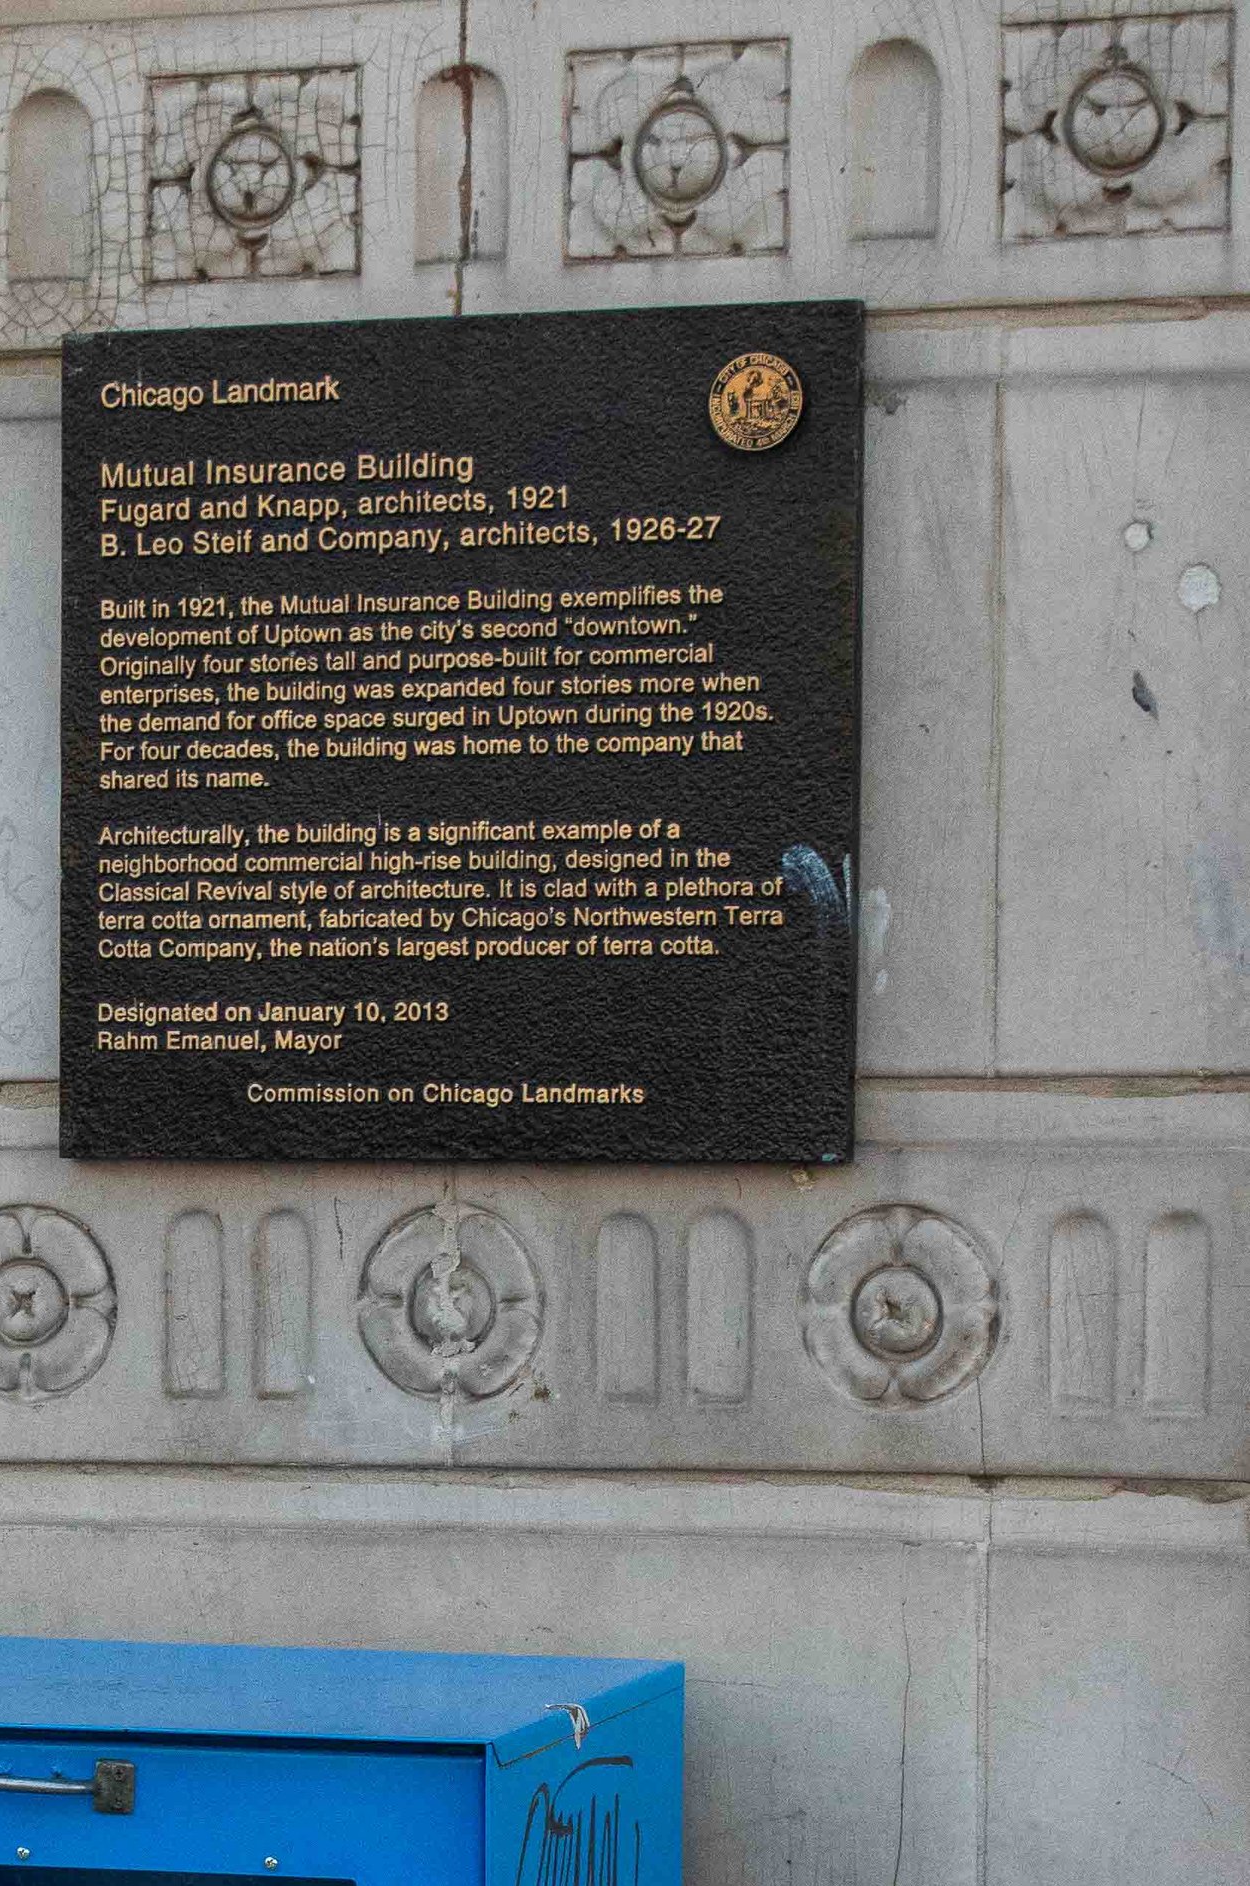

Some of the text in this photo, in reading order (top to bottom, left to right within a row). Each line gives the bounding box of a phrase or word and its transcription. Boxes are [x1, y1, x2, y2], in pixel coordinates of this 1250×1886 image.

[100, 374, 339, 410] Chicago Landmark
[101, 452, 472, 487] Mutual Insurance Building
[101, 484, 566, 525] Fugard and Knapp, architects, 1921
[101, 515, 720, 556] B. Leo Steif and Company, architects, 1926-27
[100, 584, 723, 619] Built in 1921, the Mutual Insurance Building exemplifies the
[100, 613, 697, 649] development of Uptown as the city's second "downtown."
[97, 818, 679, 848] Architecturally, the building is a significant example of a
[99, 847, 730, 877] neighborhood commercial high-rise building, designed in the
[98, 1001, 448, 1026] Designated on January 10, 2013
[97, 1029, 342, 1054] Rahm Emanuel, Mayor
[247, 1082, 644, 1107] Commission on Chicago Landmarks
